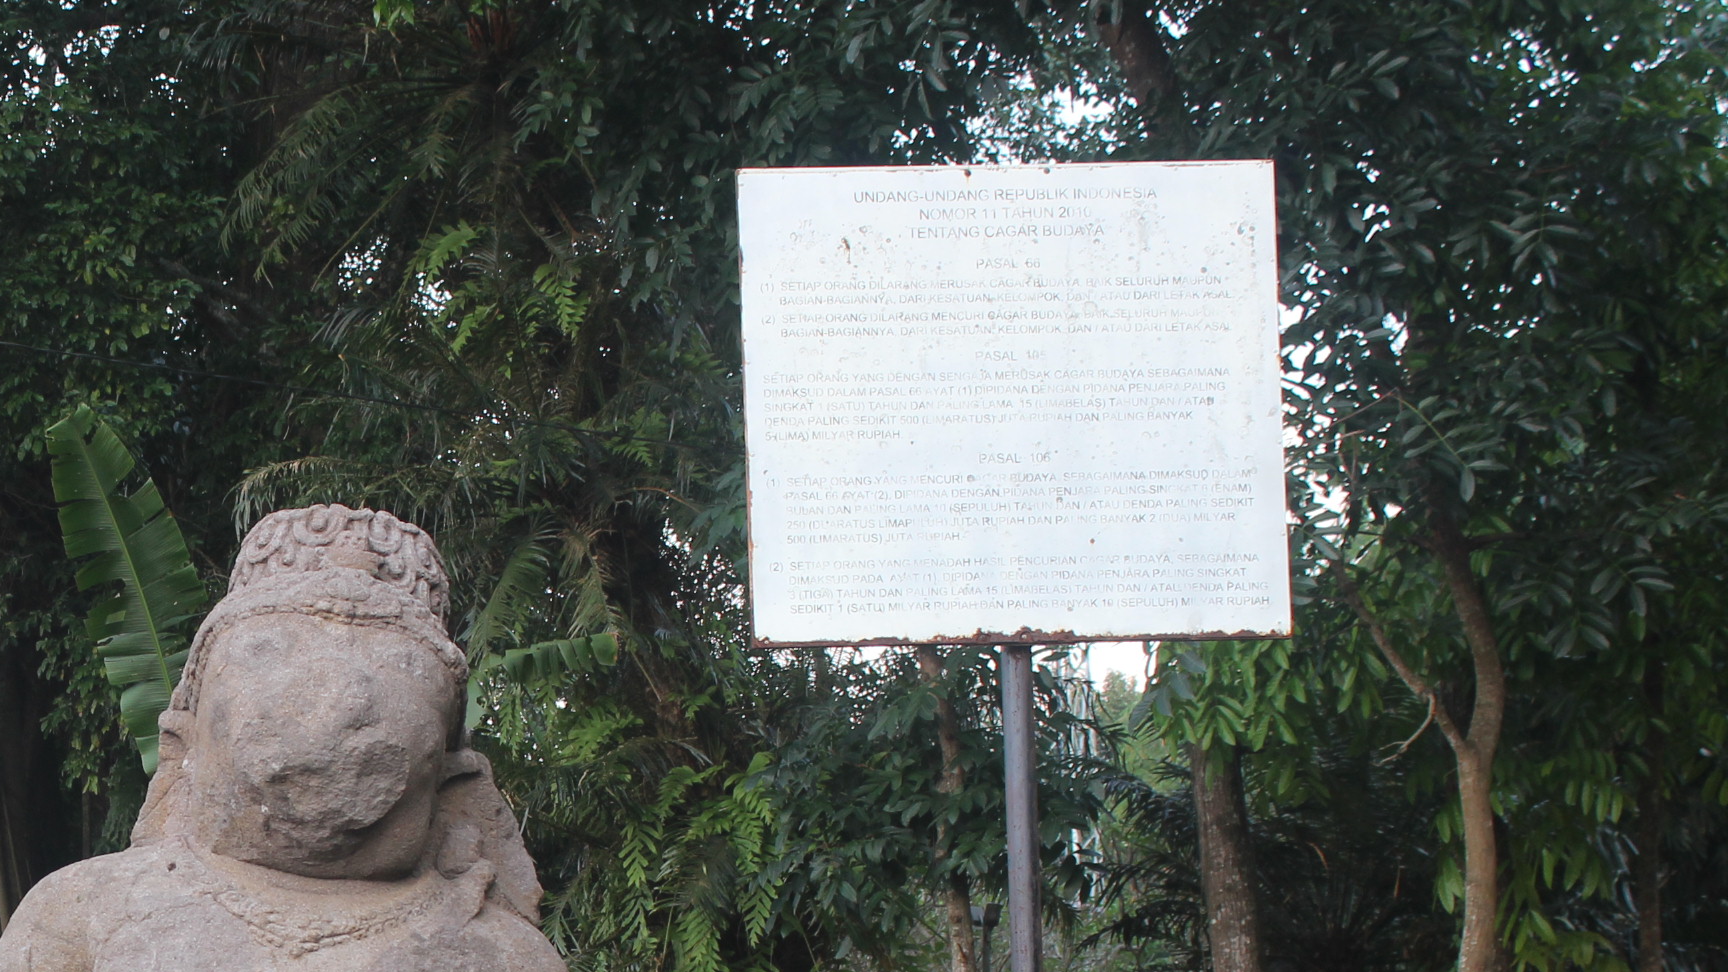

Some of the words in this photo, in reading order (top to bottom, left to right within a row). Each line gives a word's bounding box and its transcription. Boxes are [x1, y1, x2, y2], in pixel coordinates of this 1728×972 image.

[853, 189, 990, 204] UNDANG-UNDANG
[993, 188, 1069, 201] REPUBLIK
[1072, 186, 1157, 200] INDONESIA
[918, 208, 978, 220] NOMOR
[982, 207, 999, 219] 11
[1002, 207, 1055, 219] TAHUN
[907, 226, 981, 239] TENTANG
[983, 225, 1040, 238] CAGAR
[1041, 224, 1104, 237] BUDAYA
[975, 258, 1020, 269] PASAL
[780, 281, 822, 292] SETIAP
[823, 281, 867, 291] ORANG
[1114, 276, 1170, 286] SELURUH
[761, 314, 776, 325] (2)
[825, 313, 868, 323] ORANG
[931, 311, 985, 321] MENCURI
[806, 373, 850, 383] ORANG
[852, 372, 885, 383] YANG
[826, 387, 867, 397] DALAM
[869, 386, 907, 397] PASAL
[807, 416, 850, 426] PALING
[1074, 412, 1100, 422] DAN
[978, 452, 1022, 464] PASAL
[1028, 451, 1052, 463] 106
[950, 487, 1001, 498] DENGAN
[1209, 497, 1256, 508] SEDIKIT
[786, 534, 807, 544] 500
[769, 560, 784, 571] (2)
[852, 573, 884, 583] PADA
[1196, 567, 1247, 577] SINGKAT
[836, 588, 876, 598] TAHUN
[878, 587, 904, 597] DAN
[985, 586, 999, 595] 15
[1227, 581, 1269, 591] PALING
[1225, 595, 1271, 606] RUPIAH
